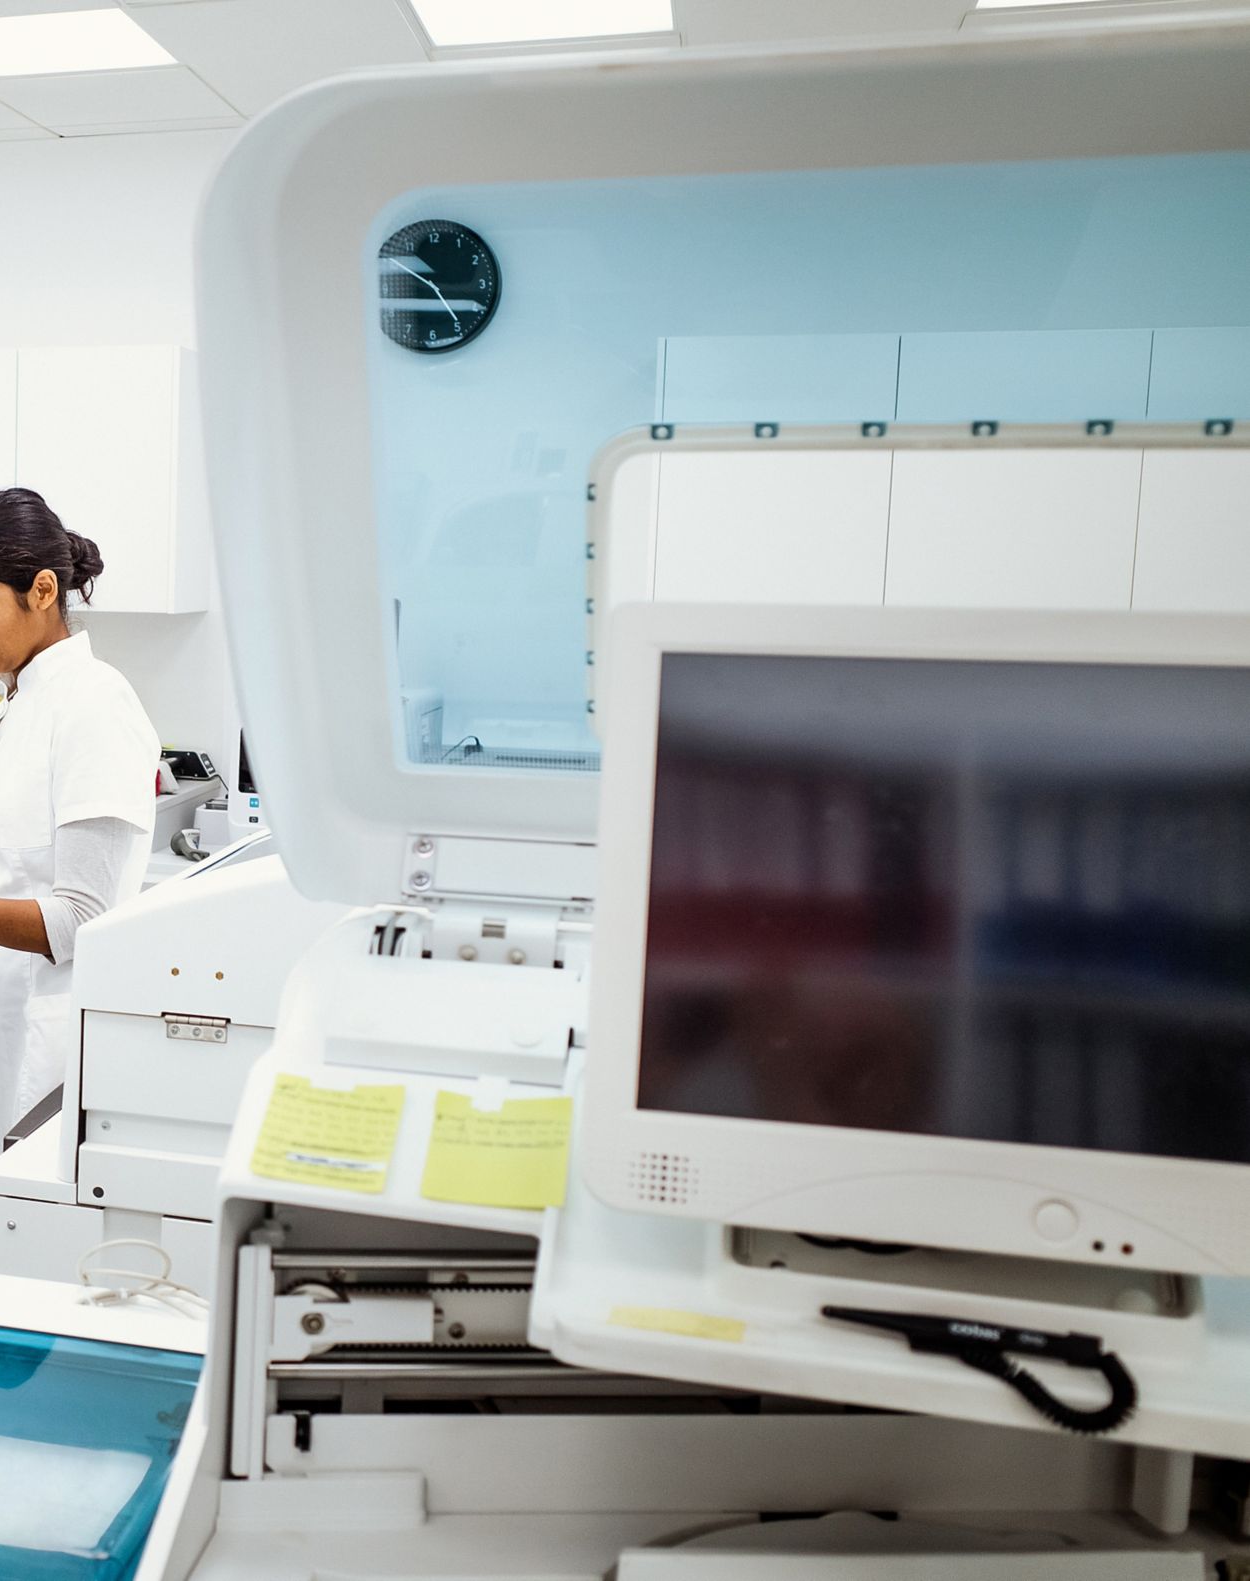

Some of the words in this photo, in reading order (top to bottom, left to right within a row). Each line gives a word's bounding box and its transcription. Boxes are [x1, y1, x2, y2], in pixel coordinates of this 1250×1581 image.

[429, 233, 439, 243] 12
[405, 243, 414, 252] 11
[456, 238, 461, 249] 1
[472, 255, 479, 265] 2
[479, 279, 486, 289] 3
[405, 323, 411, 333] 7
[454, 322, 461, 332] 5
[430, 330, 437, 340] 6
